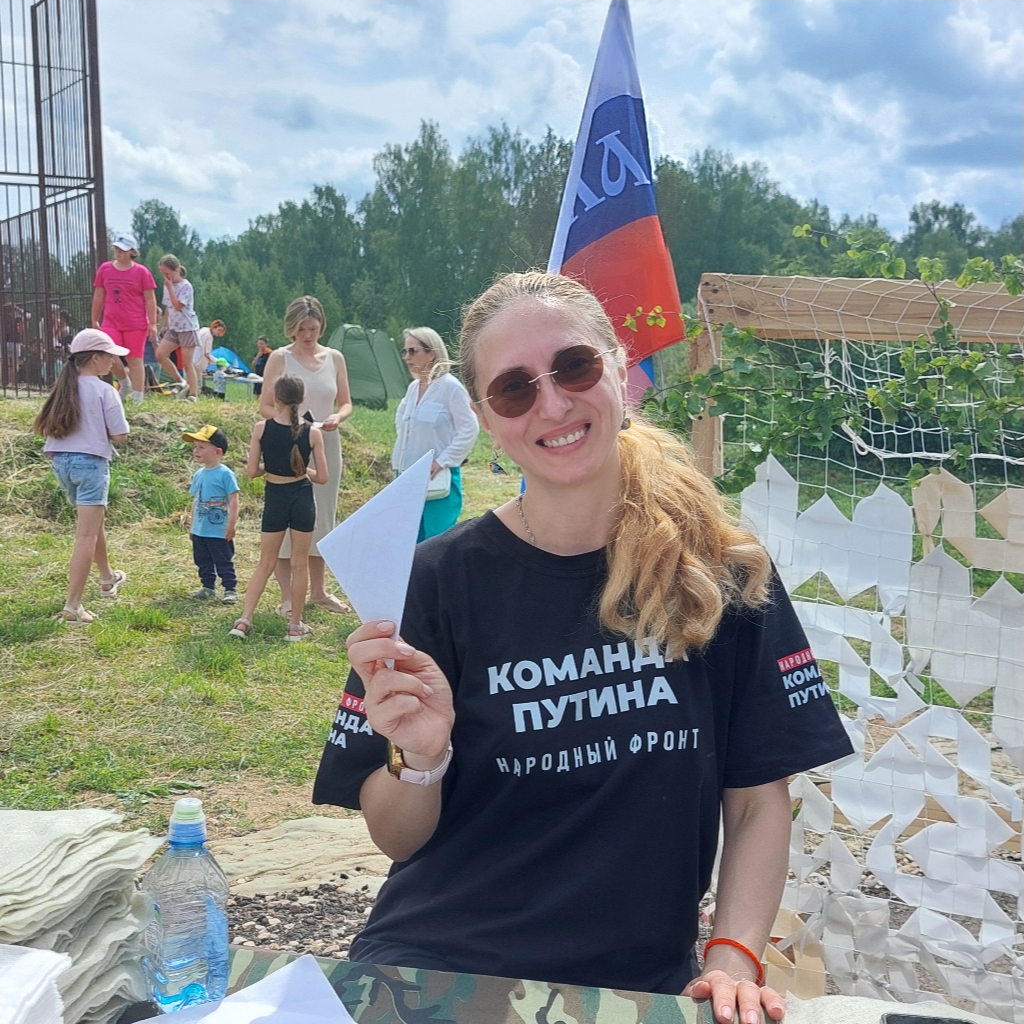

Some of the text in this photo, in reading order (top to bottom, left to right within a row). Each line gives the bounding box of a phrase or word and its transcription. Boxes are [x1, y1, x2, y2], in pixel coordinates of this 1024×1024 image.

[778, 649, 815, 672] НАРОДН
[345, 696, 366, 712] ФРО
[512, 676, 679, 733] ПУТИНА
[788, 681, 830, 708] ПУТИ
[496, 728, 700, 778] НАРОДНЫЙ ФРОНТ
